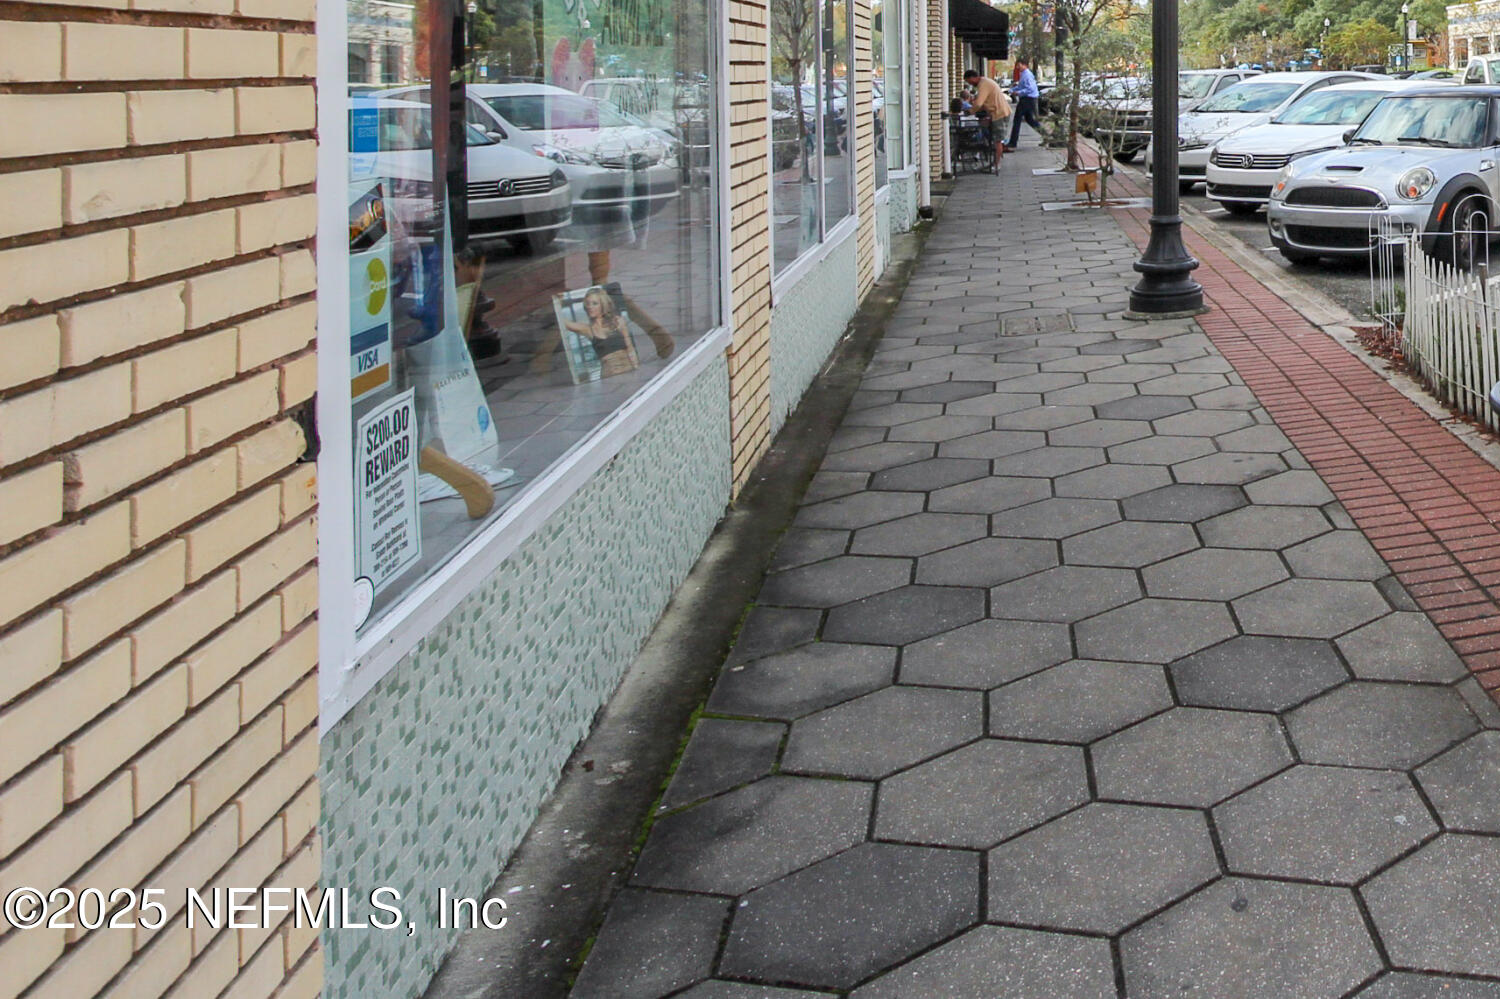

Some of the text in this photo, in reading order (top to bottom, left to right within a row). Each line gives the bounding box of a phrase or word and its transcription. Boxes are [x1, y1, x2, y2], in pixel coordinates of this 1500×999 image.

[358, 348, 379, 372] VISA
[366, 405, 409, 456] $200.00
[365, 435, 410, 487] REWARD
